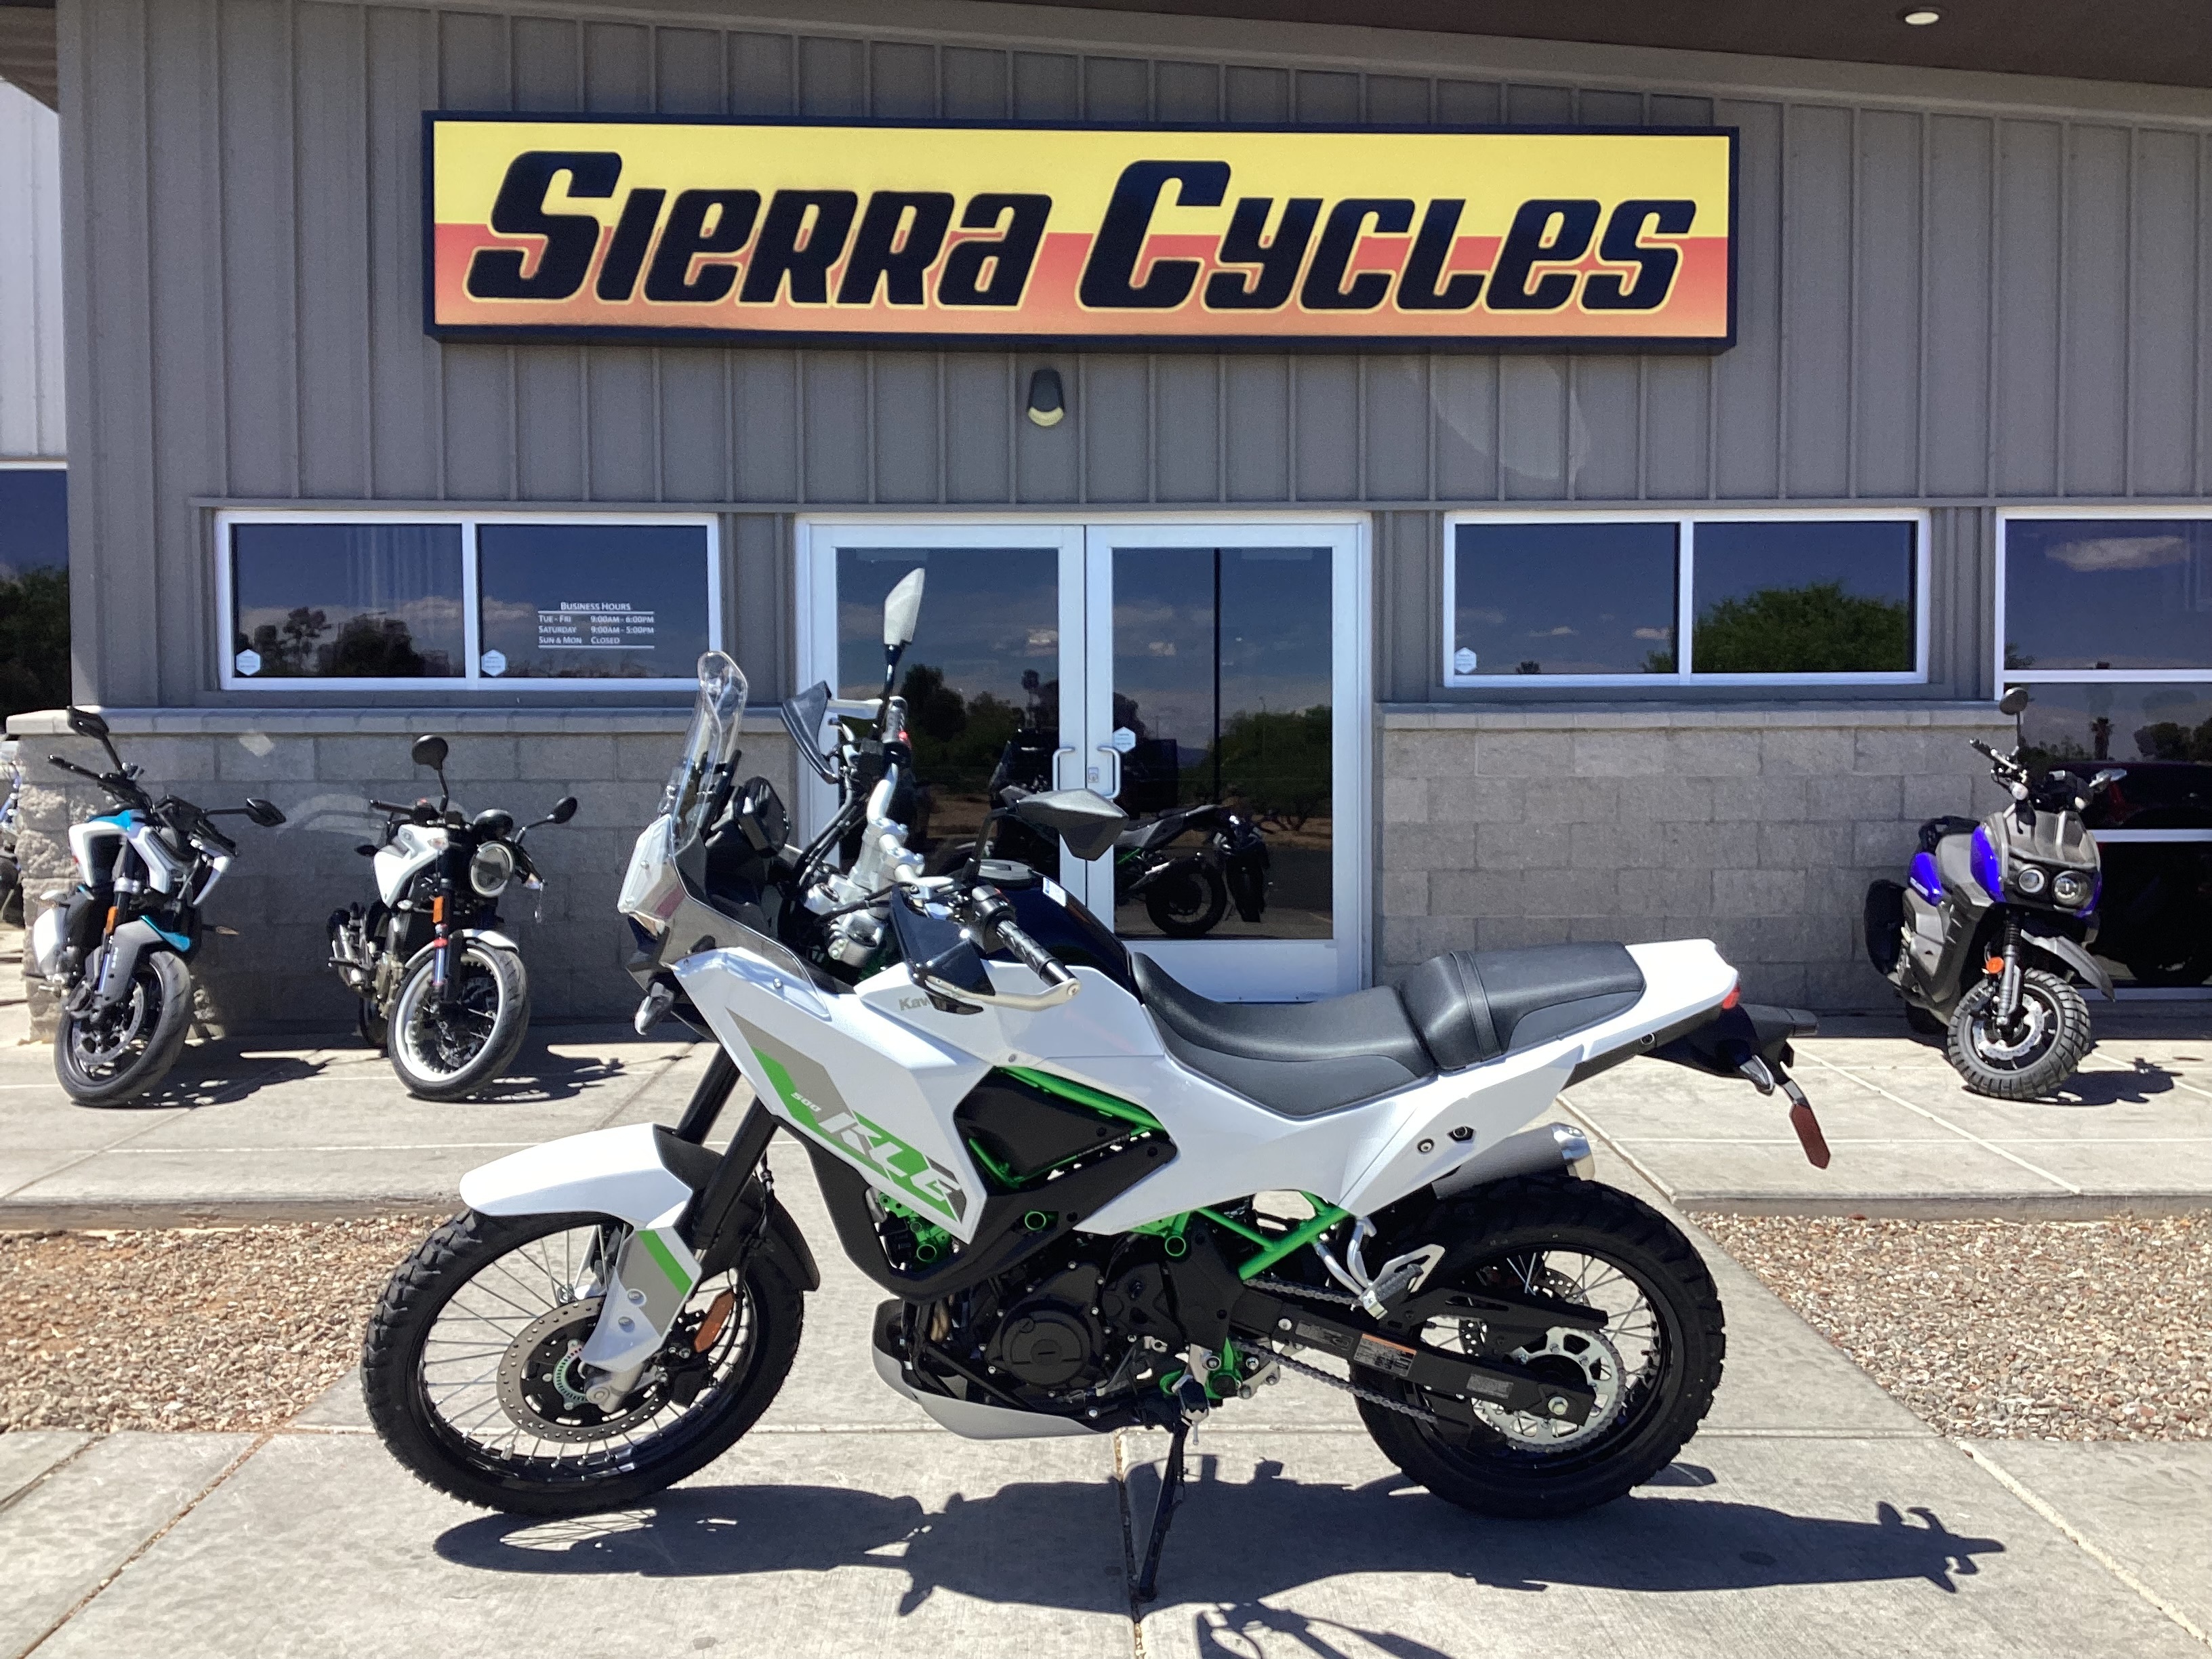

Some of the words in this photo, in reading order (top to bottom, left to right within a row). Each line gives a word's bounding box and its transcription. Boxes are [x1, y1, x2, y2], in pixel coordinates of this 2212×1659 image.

[560, 601, 600, 611] BUSINESS
[601, 602, 631, 611] HOURS
[539, 615, 554, 623] TUE
[559, 615, 571, 623] FRI
[590, 615, 620, 623] 9:00AM
[538, 626, 577, 634] SATURDAY
[590, 626, 620, 634] 9:00AM
[538, 636, 555, 644] SUN
[590, 636, 620, 644] CLOSED
[790, 1092, 822, 1113] 500
